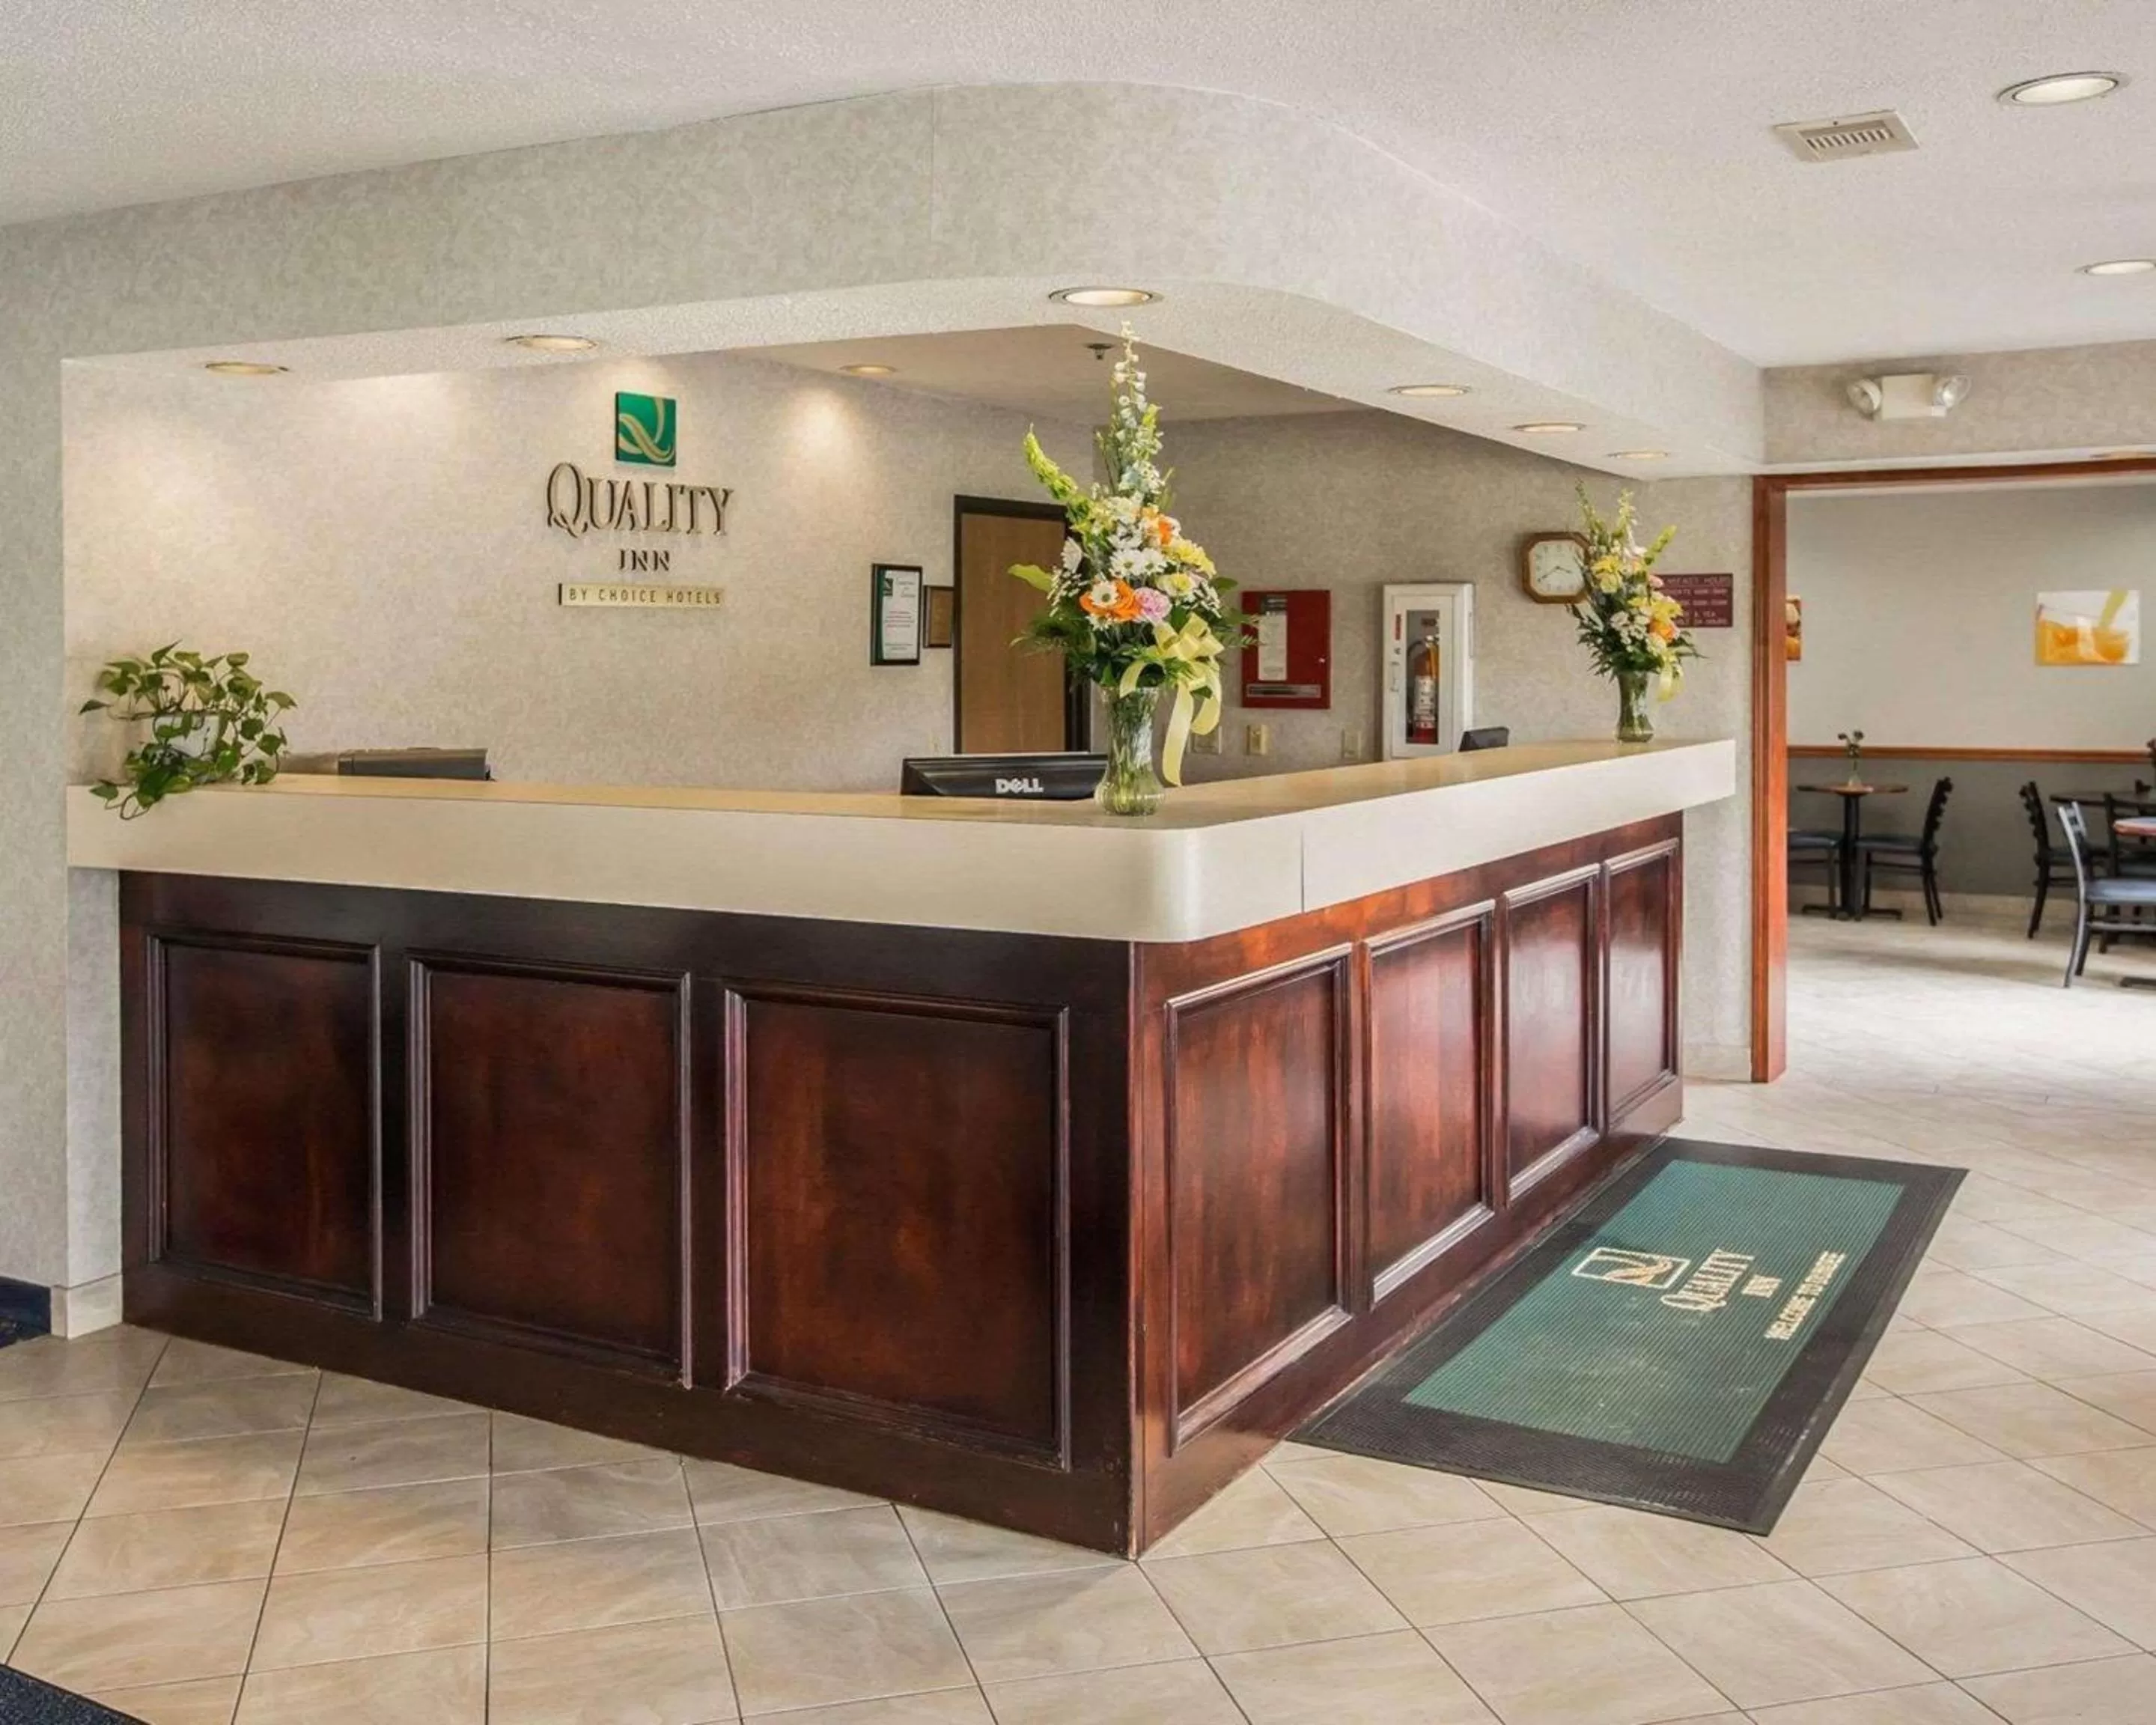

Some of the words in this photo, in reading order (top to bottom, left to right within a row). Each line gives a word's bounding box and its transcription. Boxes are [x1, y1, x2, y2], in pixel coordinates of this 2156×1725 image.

[546, 462, 734, 538] QUALITY
[618, 549, 670, 571] INN
[569, 588, 588, 600] BY
[598, 588, 657, 603] CHOICE
[666, 591, 721, 604] HOTELS
